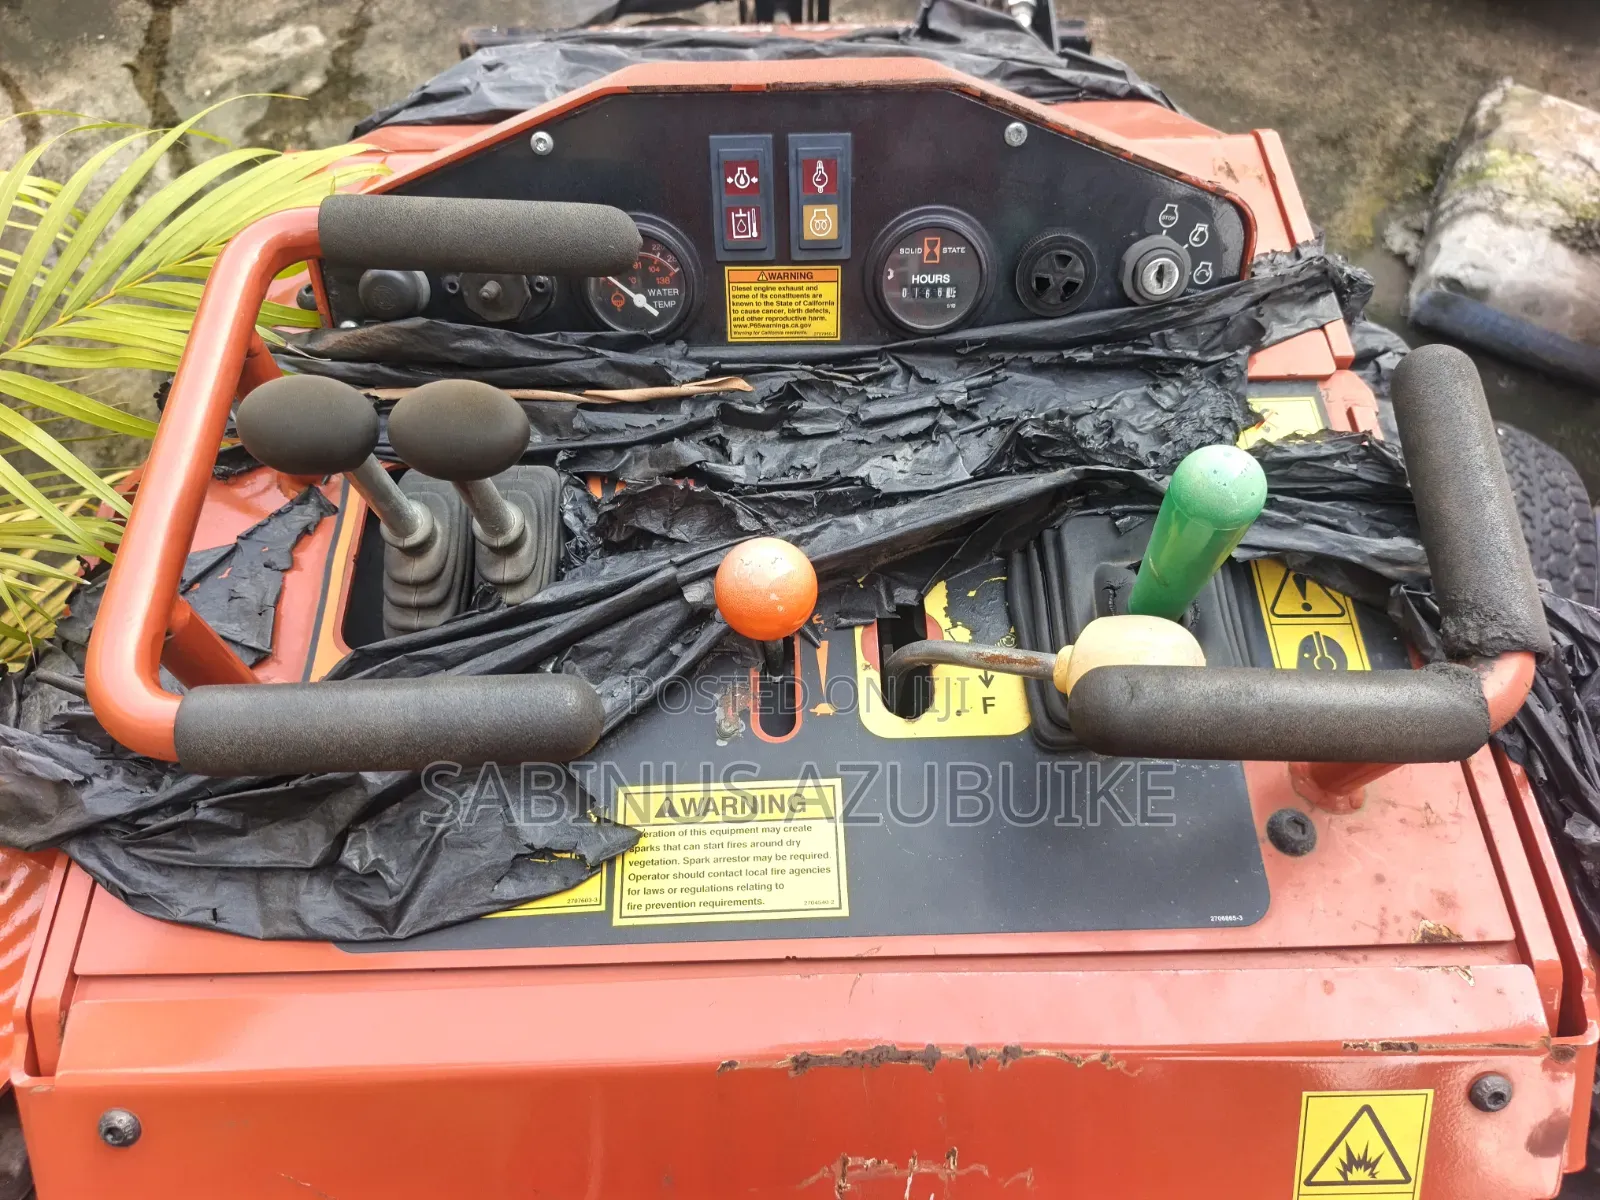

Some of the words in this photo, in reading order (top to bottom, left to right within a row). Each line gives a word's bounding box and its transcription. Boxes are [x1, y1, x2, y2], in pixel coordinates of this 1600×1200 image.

[899, 247, 923, 255] SOLID
[942, 246, 966, 254] STATE
[768, 271, 814, 281] WARNING
[911, 273, 951, 284] HOURS
[648, 288, 680, 297] WATER
[652, 300, 677, 309] TEMP
[804, 307, 831, 315] defects,
[765, 315, 807, 323] reproductive
[732, 322, 812, 330] www.P65warnings.ca.gov
[981, 696, 996, 714] F
[680, 793, 807, 817] WARNING
[678, 828, 688, 837] of
[689, 827, 707, 836] this
[709, 825, 759, 838] equipment
[761, 826, 781, 836] may
[783, 824, 812, 833] create
[663, 842, 682, 852] that
[683, 843, 701, 852] can
[703, 841, 725, 850] start
[726, 840, 748, 849] fires
[750, 838, 784, 848] around
[785, 838, 802, 849] dry
[628, 856, 680, 869] vegetation.
[682, 854, 710, 866] Spark
[713, 854, 750, 864] arrestor
[752, 853, 773, 865] may
[774, 852, 788, 862] be
[789, 850, 832, 863] required.
[627, 871, 670, 884] Operator
[672, 870, 705, 880] should
[707, 868, 743, 879] contact
[745, 867, 768, 877] local
[770, 866, 786, 876] fire
[788, 865, 832, 877] agencies
[627, 886, 641, 896] for
[643, 885, 665, 896] laws
[667, 886, 678, 895] or
[680, 883, 734, 896] regulations
[736, 882, 773, 895] relating
[774, 881, 785, 891] to
[626, 900, 643, 911] fire
[644, 899, 696, 913] prevention
[698, 896, 765, 911] requirements.
